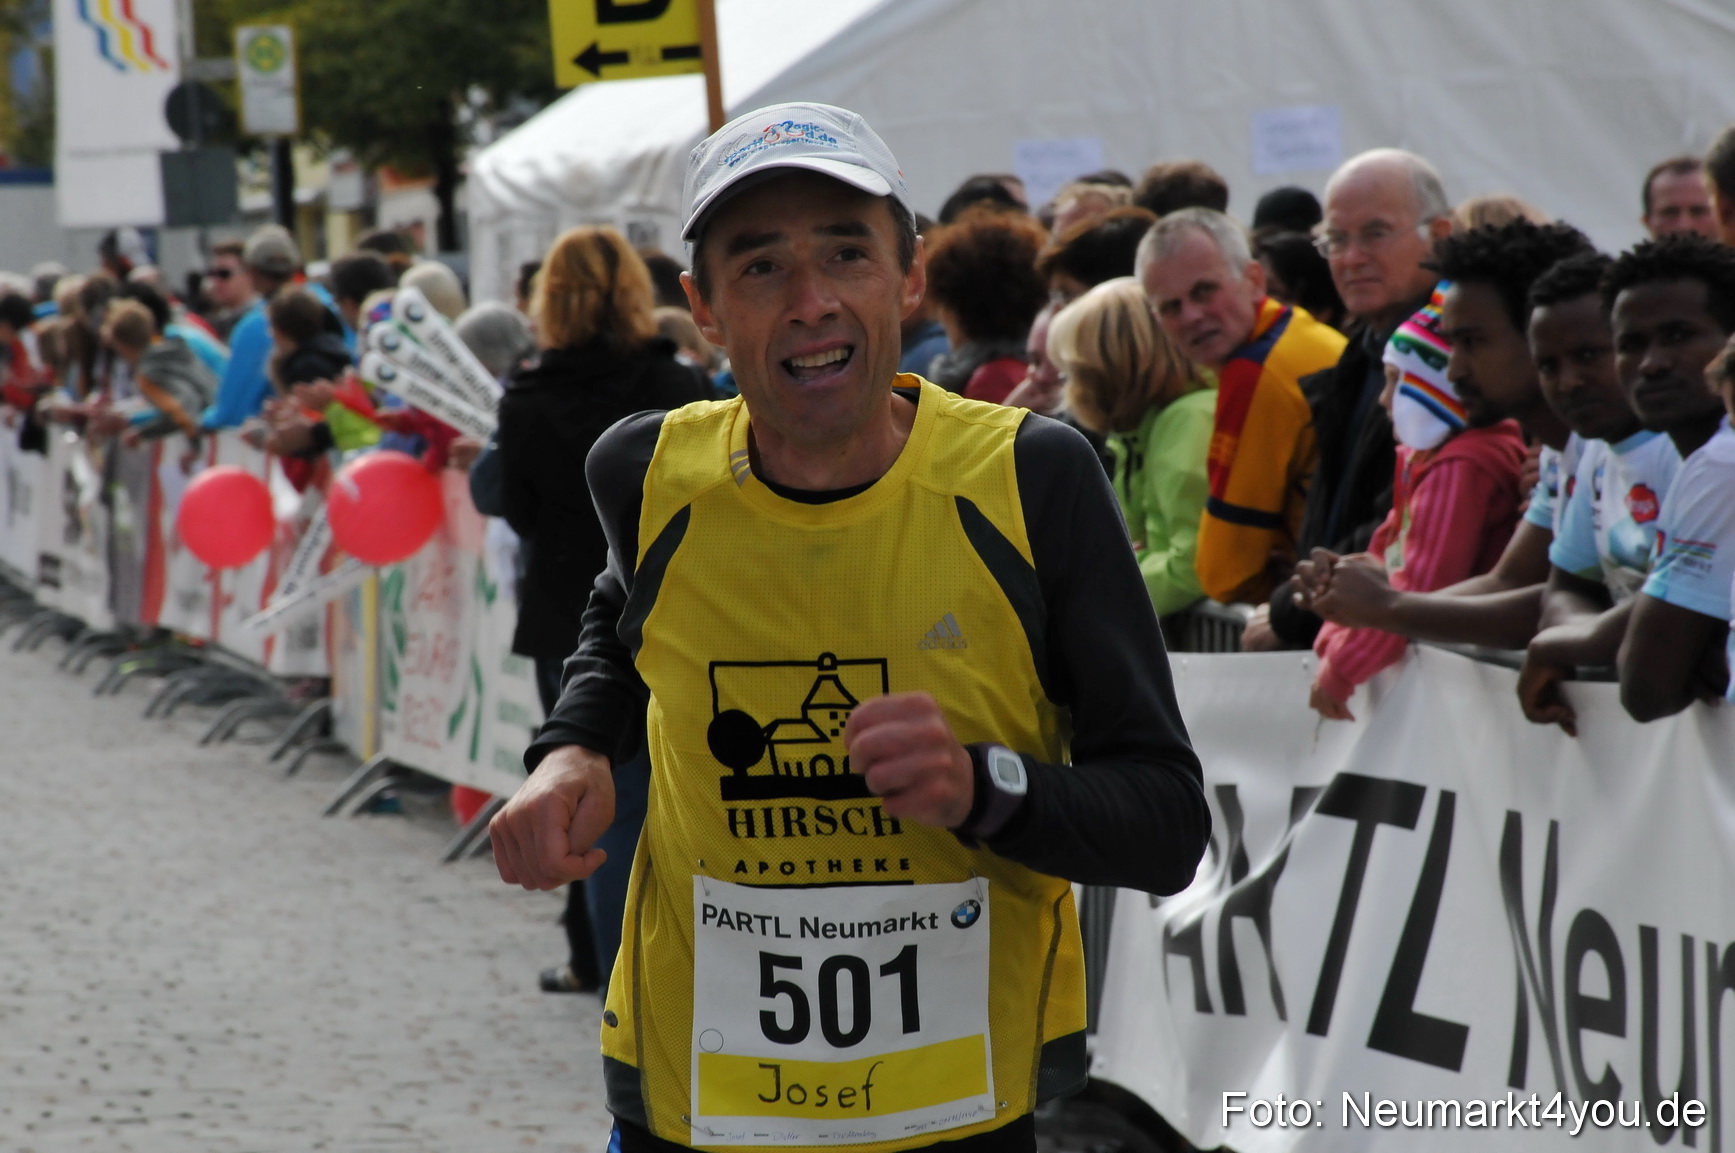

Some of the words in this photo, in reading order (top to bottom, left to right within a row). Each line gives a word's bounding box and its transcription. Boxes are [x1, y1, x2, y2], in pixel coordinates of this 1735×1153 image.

[726, 805, 903, 839] HIRSCH
[734, 858, 910, 876] APOTHEKE
[702, 902, 791, 939] PARTL
[800, 911, 938, 939] Neumarkt
[1150, 772, 1470, 1073] ARTL
[759, 944, 921, 1048] 501
[758, 1061, 884, 1111] Josef
